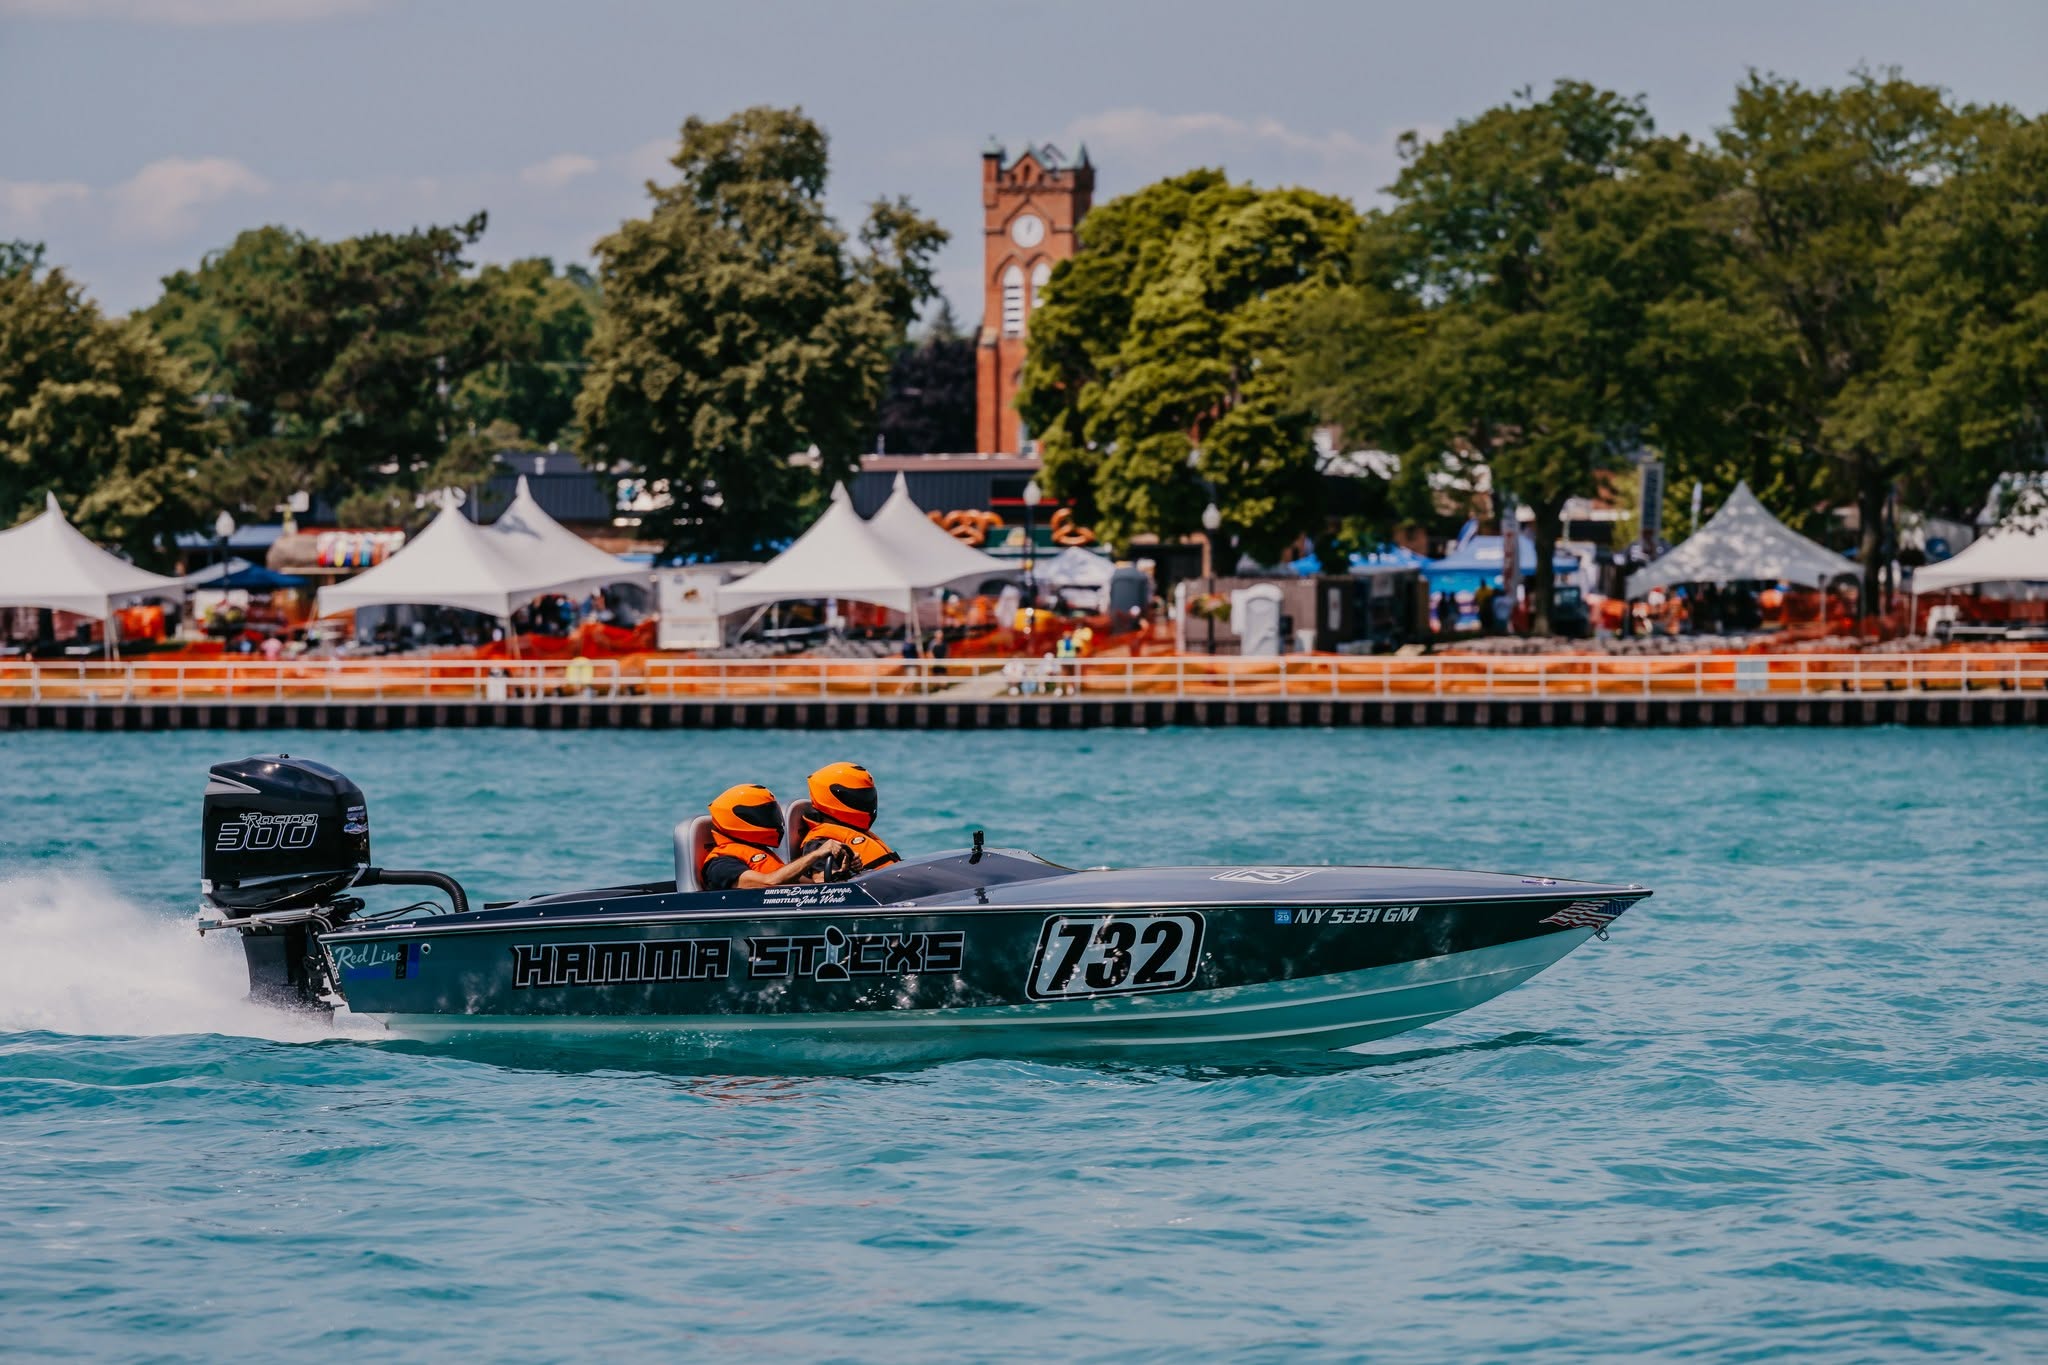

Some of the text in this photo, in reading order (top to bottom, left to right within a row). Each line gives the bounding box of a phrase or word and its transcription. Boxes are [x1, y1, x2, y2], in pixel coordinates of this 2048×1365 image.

[215, 822, 317, 850] 300
[1294, 907, 1420, 924] NY 5331 GM
[335, 944, 369, 969] Red
[368, 944, 402, 967] Line
[512, 937, 732, 989] HAMMA
[1046, 920, 1184, 991] 732
